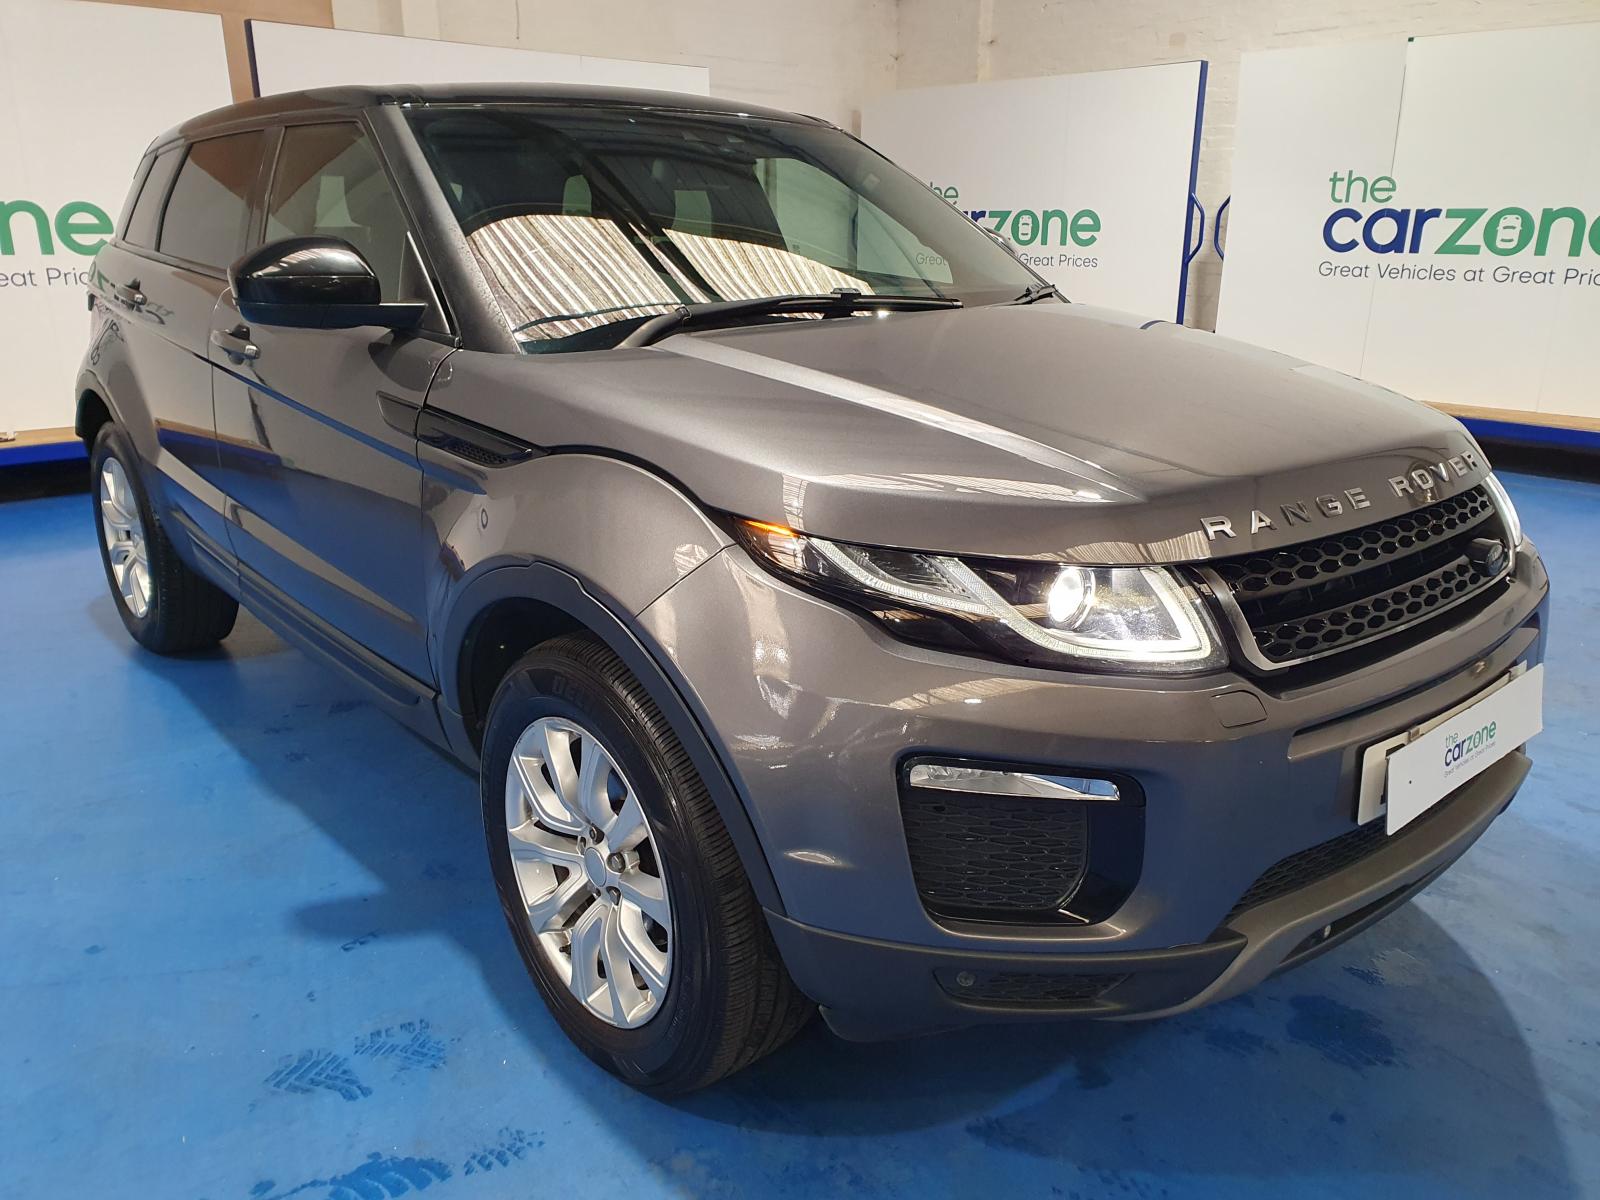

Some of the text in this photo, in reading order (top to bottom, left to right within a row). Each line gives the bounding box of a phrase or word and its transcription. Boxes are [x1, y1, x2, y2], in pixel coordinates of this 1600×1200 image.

[1329, 170, 1397, 203] the
[1322, 206, 1600, 257] carzon
[1019, 253, 1098, 268] Great Prices
[1318, 260, 1370, 278] Great
[1377, 263, 1456, 281] Vehicles
[1463, 267, 1485, 282] at
[1493, 266, 1556, 284] Great
[1200, 450, 1478, 541] RANGE ROVER
[1445, 732, 1459, 748] the
[1445, 721, 1496, 767] carzone
